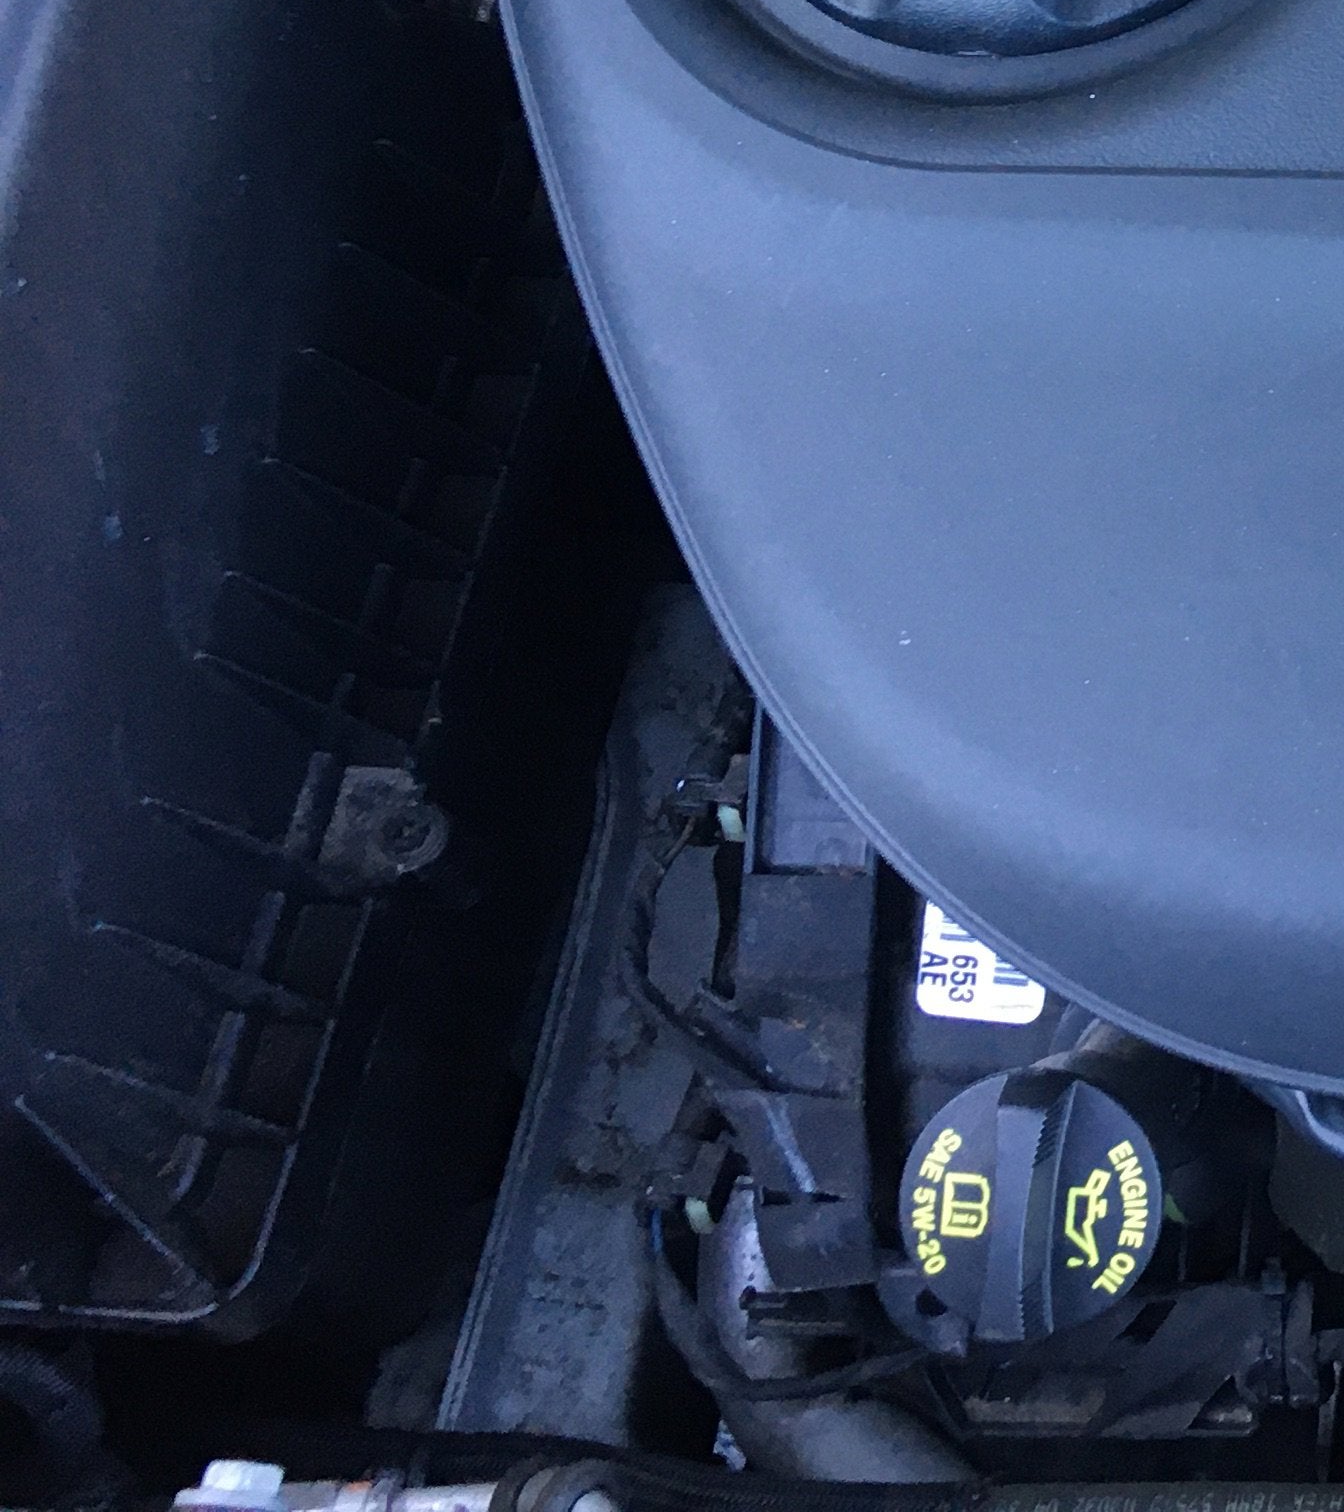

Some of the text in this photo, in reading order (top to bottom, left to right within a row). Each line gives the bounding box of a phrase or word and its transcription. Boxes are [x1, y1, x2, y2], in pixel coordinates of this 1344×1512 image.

[920, 951, 948, 987] AE
[948, 954, 979, 1004] 653
[912, 1128, 962, 1276] SAE 5W-20
[1091, 1140, 1149, 1294] ENGINE OIL
